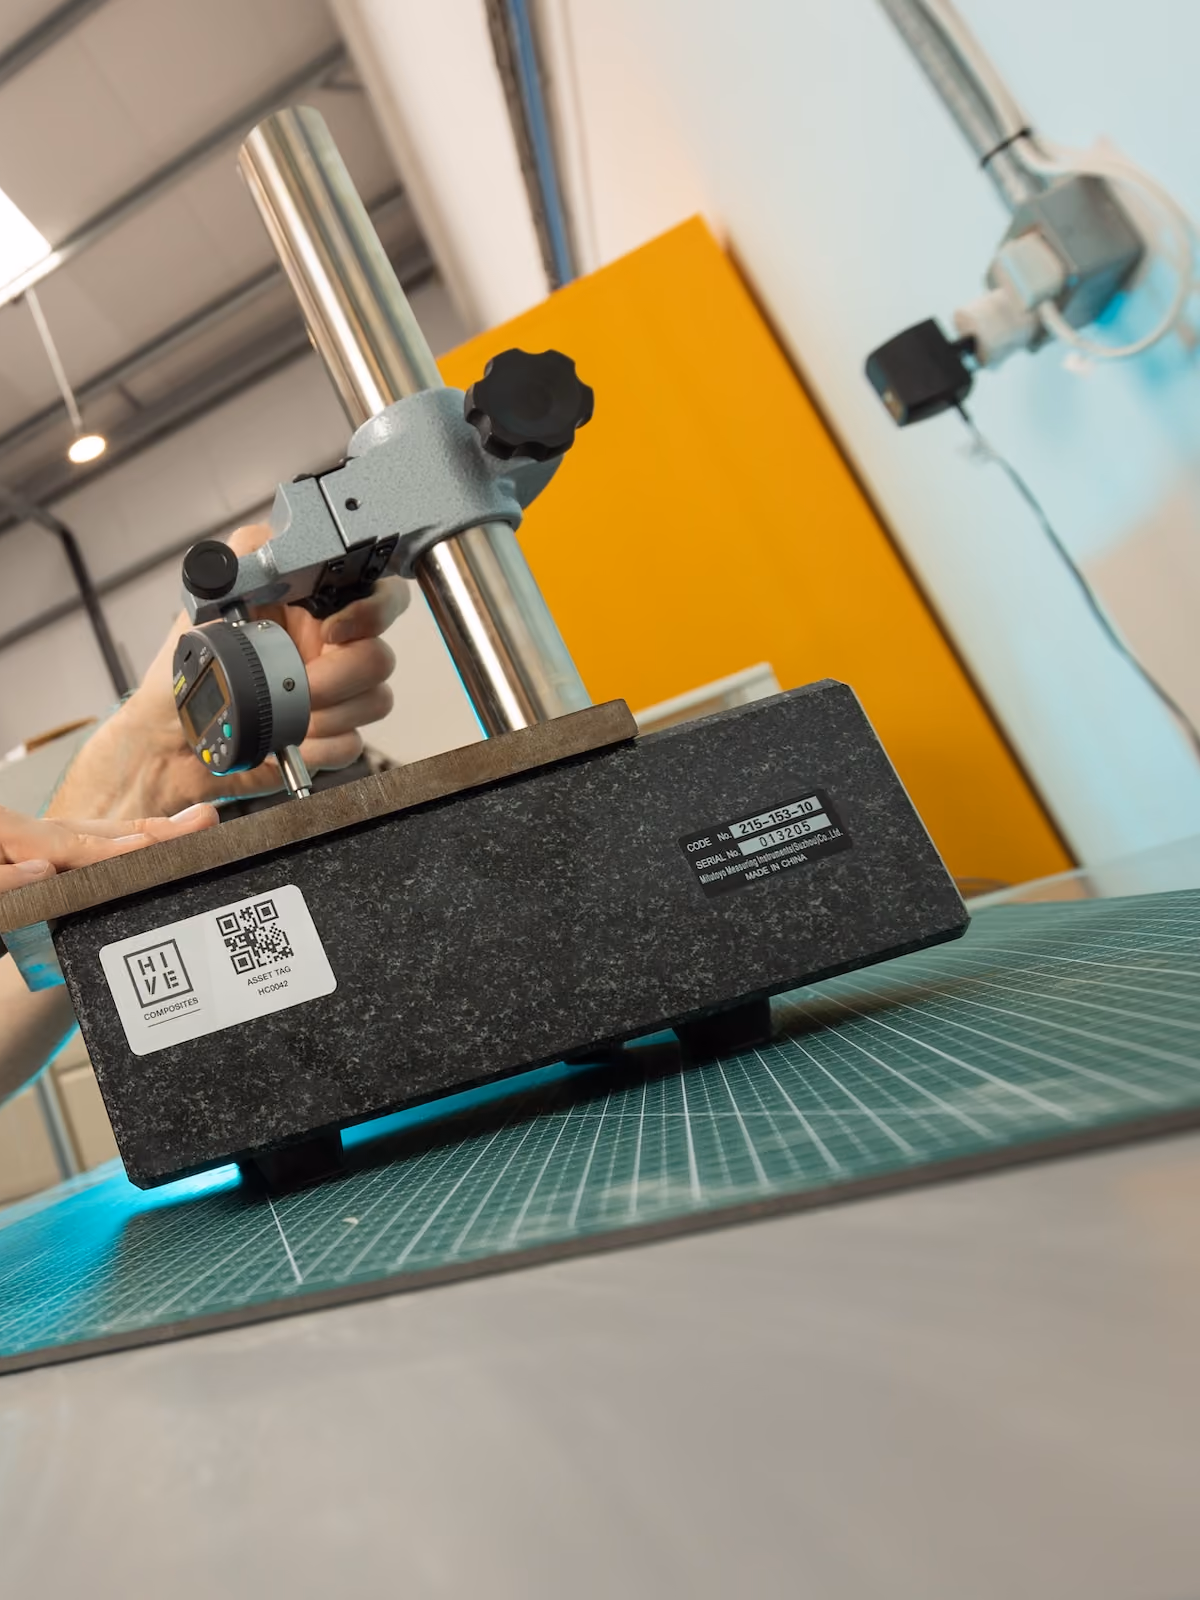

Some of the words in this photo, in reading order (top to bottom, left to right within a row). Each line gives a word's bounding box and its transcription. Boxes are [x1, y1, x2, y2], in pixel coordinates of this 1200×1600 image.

[686, 837, 712, 853] CODE
[717, 829, 732, 842] No.
[738, 801, 813, 834] 215-153-10
[695, 853, 726, 870] SERIAL
[726, 849, 741, 860] No.
[758, 820, 811, 848] 013205
[725, 857, 759, 876] Measuring
[745, 866, 770, 881] MADE
[770, 863, 781, 872] IN
[781, 853, 808, 869] CHINA
[247, 970, 273, 986] ASSET
[274, 965, 292, 978] TAG
[257, 980, 289, 996] HC0042
[143, 996, 199, 1021] COMPOSITES
